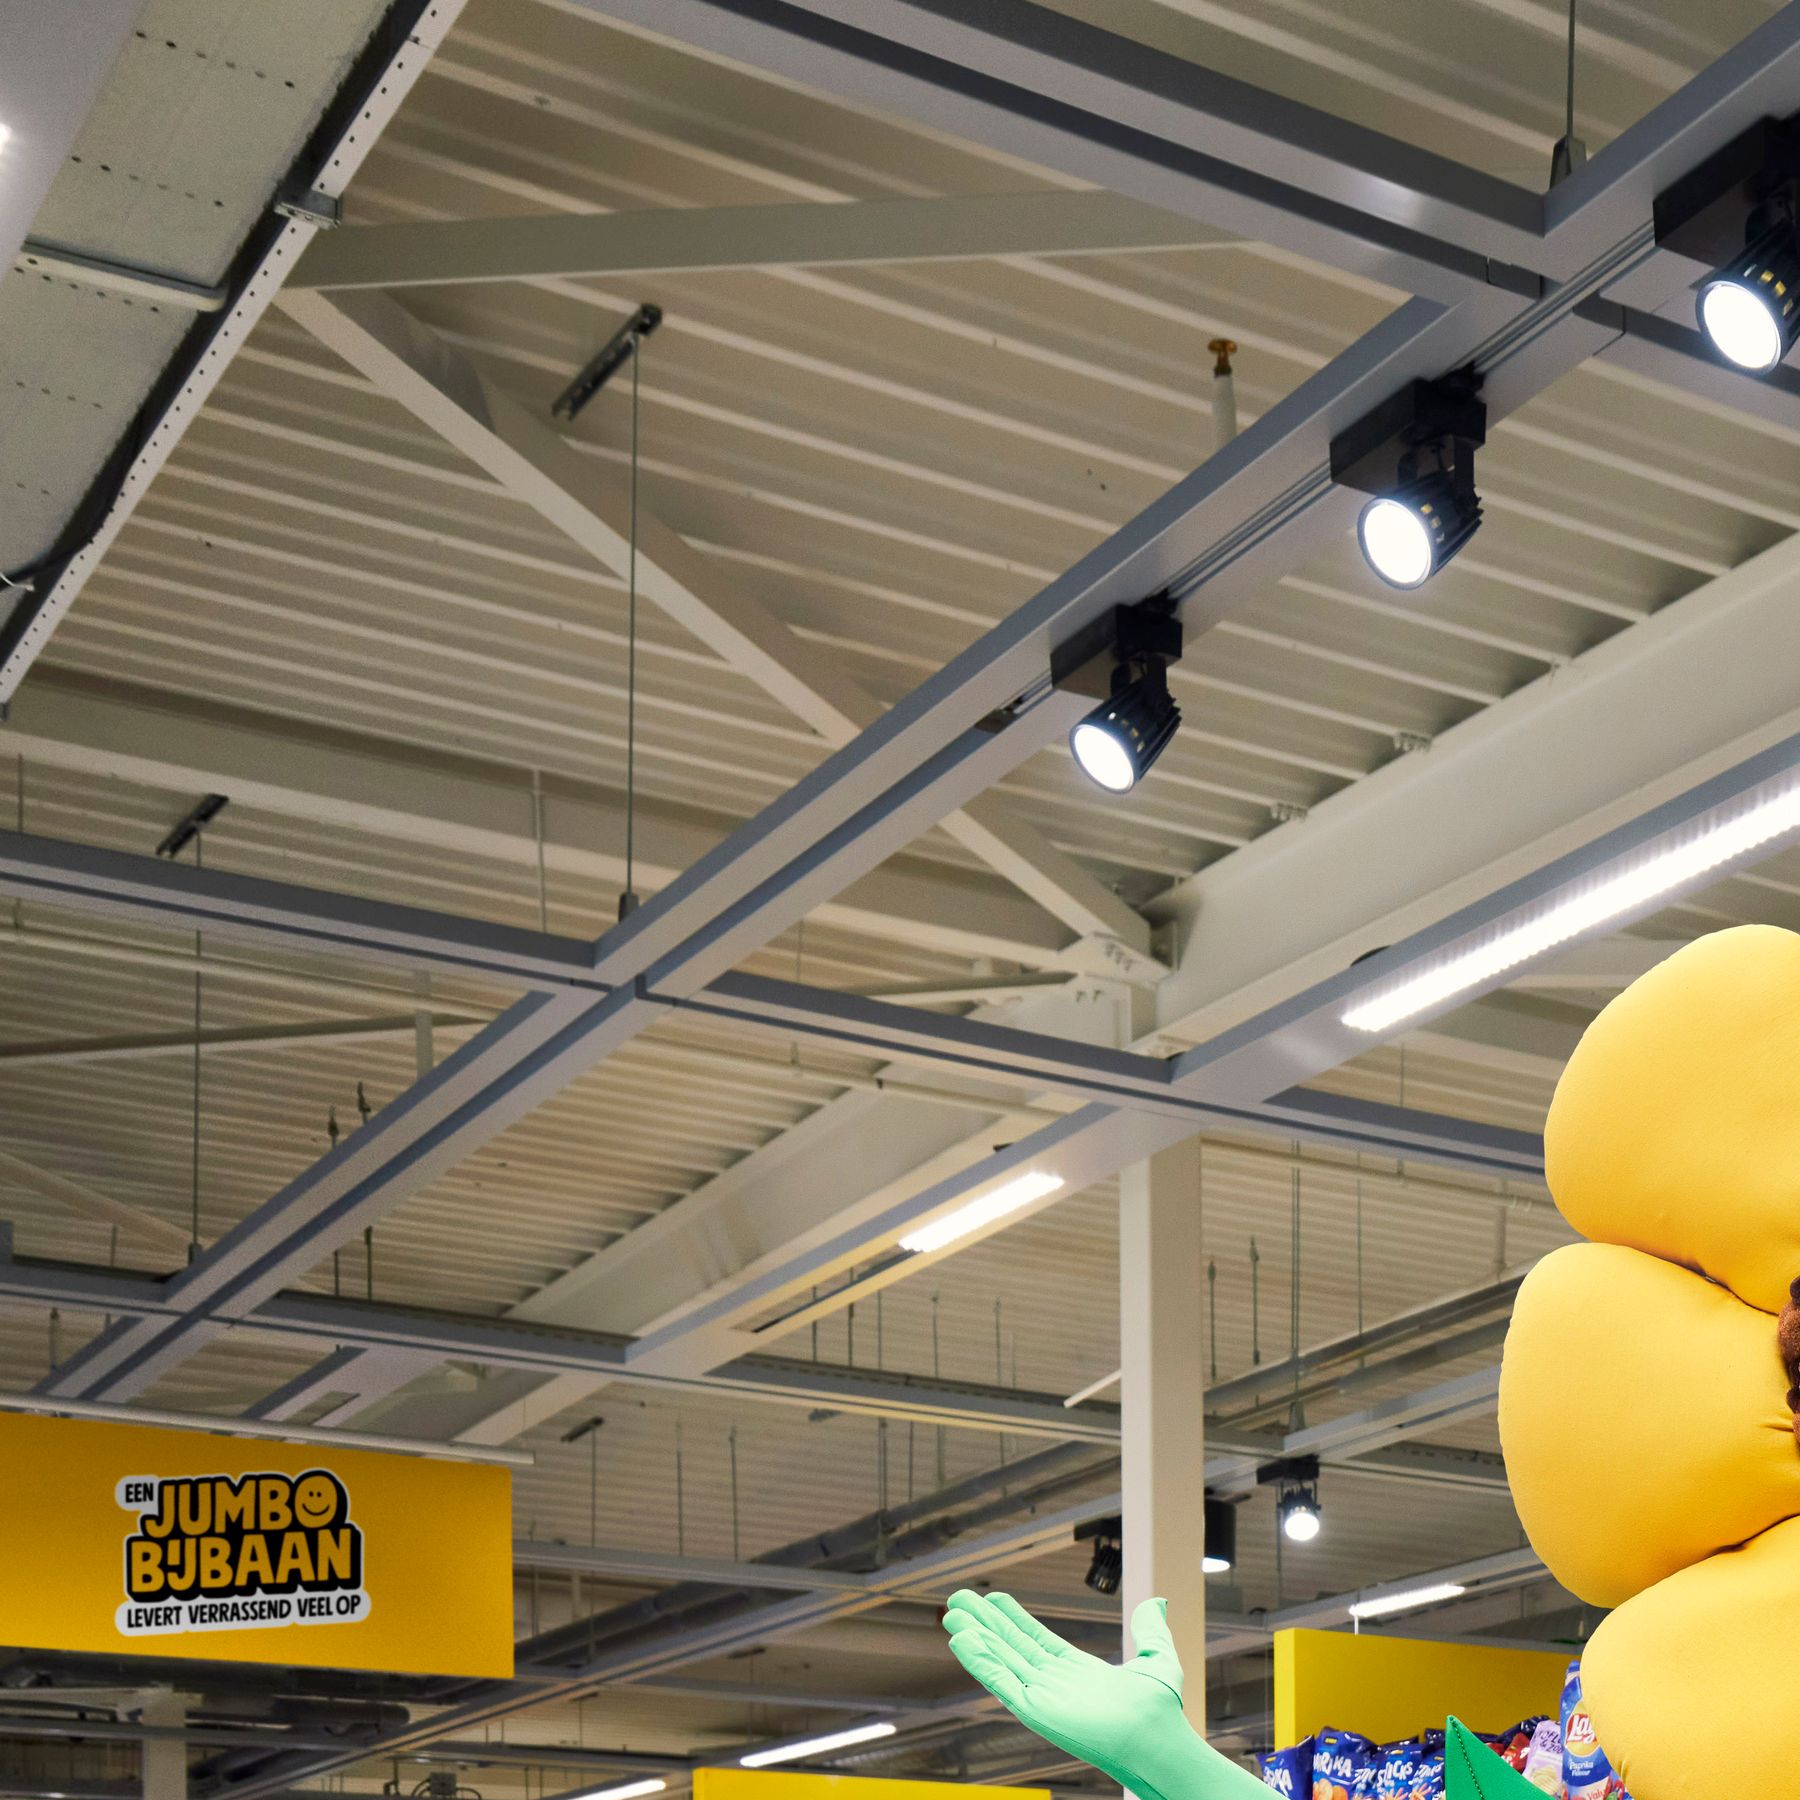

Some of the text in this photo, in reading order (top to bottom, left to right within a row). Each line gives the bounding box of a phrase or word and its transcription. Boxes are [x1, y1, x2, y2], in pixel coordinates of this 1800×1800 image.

[125, 1483, 154, 1503] EEN
[144, 1475, 338, 1539] JUMBO
[131, 1528, 351, 1593] BIJBAAN
[127, 1594, 361, 1628] LEVERT VERRASSEND VEEL OP
